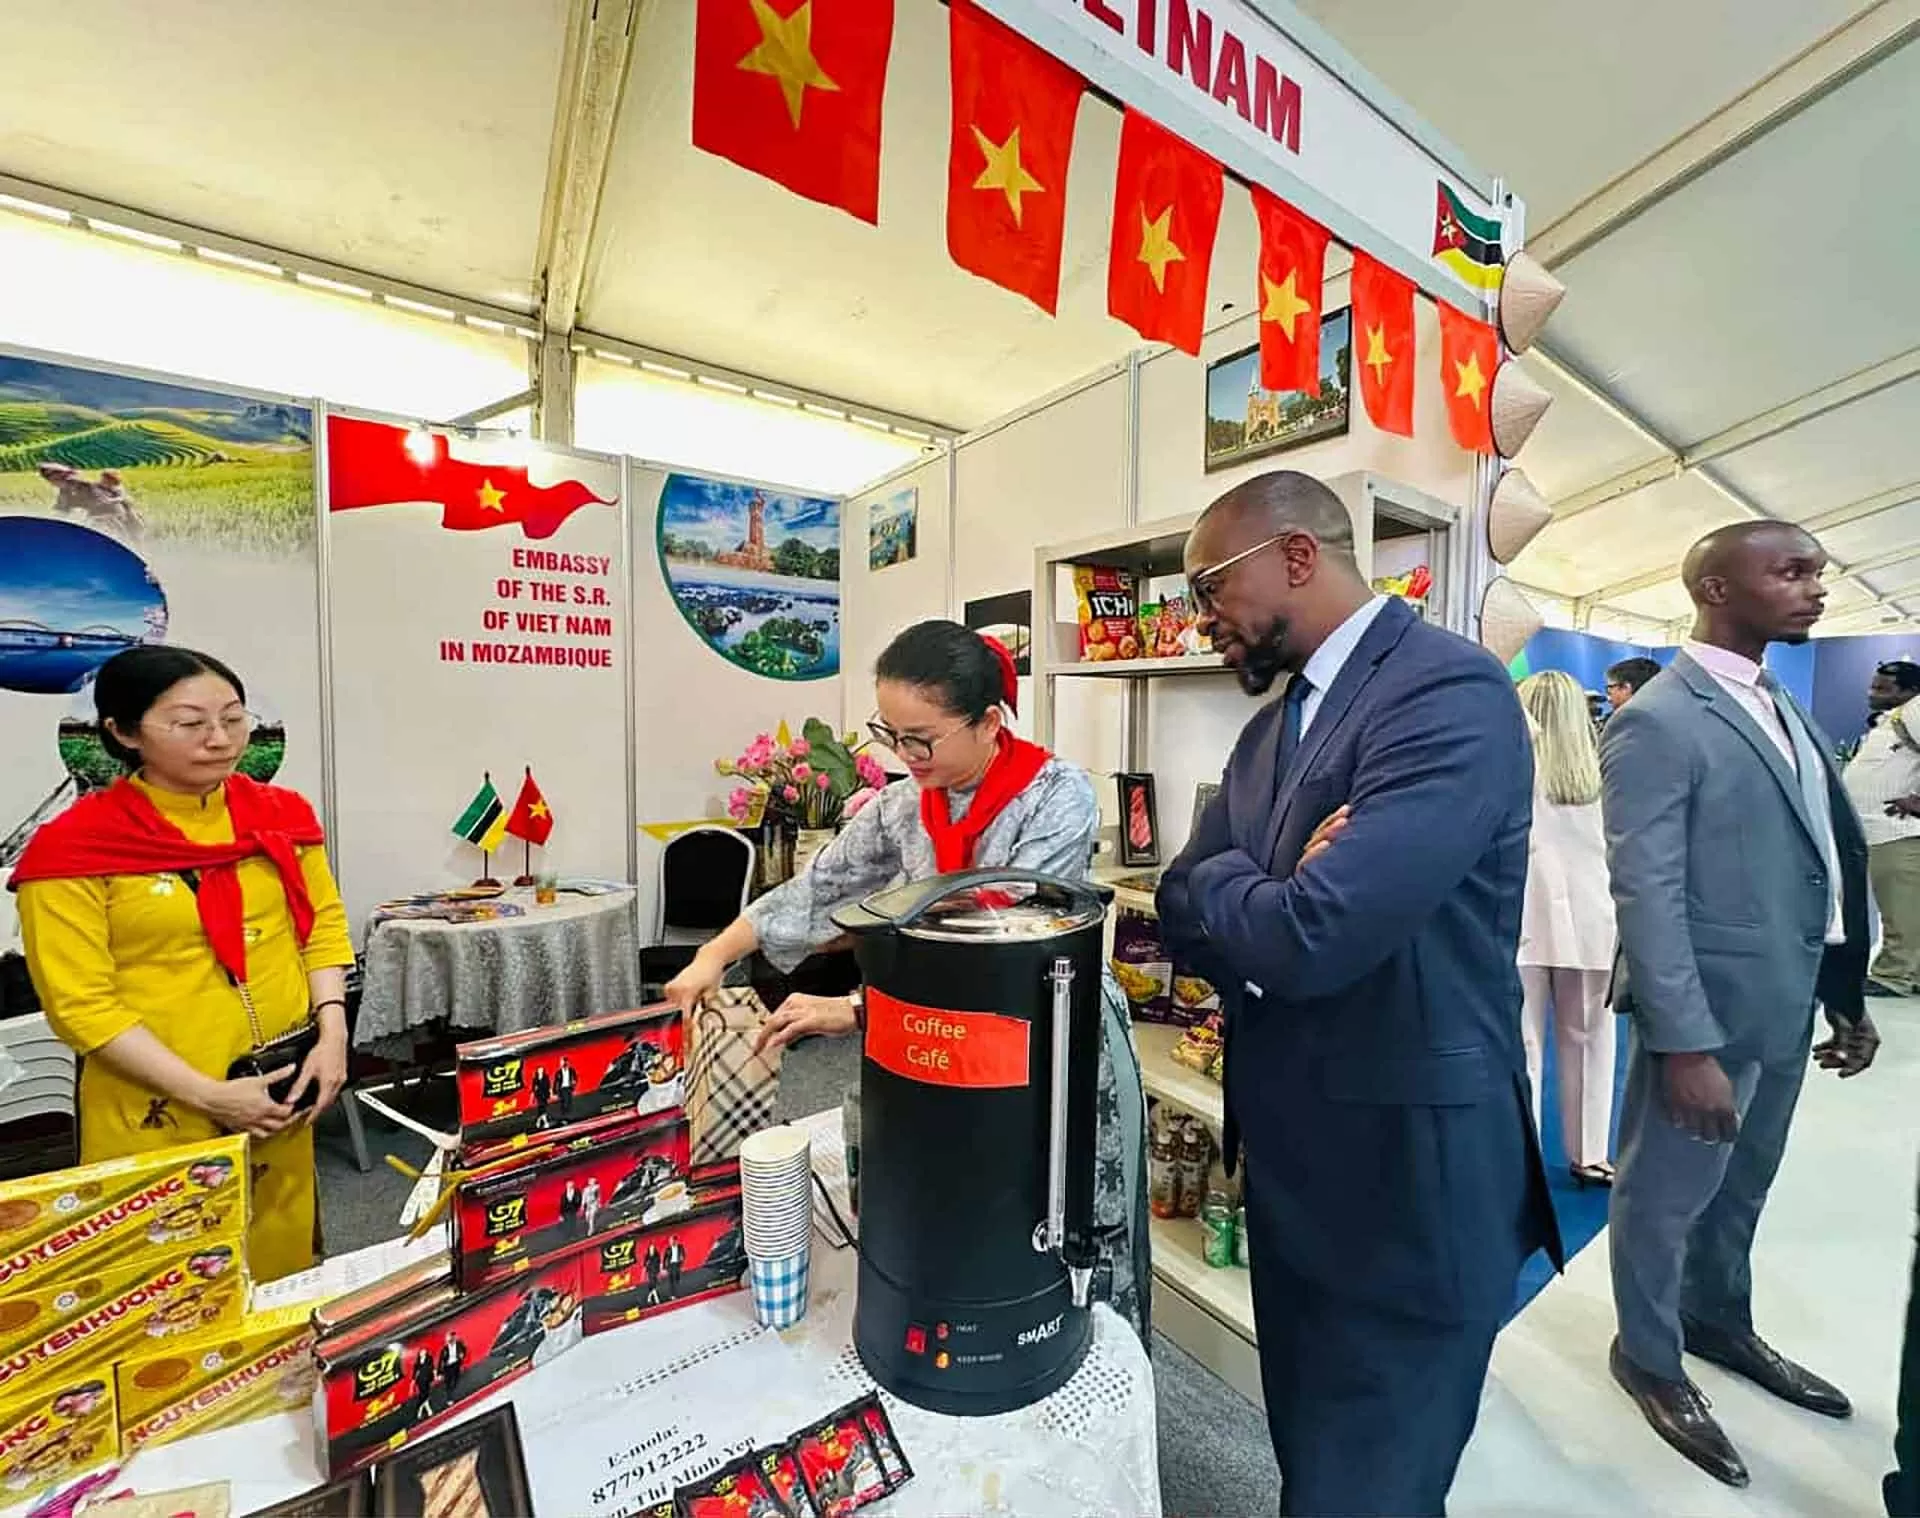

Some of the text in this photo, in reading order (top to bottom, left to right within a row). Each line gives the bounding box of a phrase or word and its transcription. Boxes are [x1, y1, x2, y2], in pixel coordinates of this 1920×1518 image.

[513, 548, 610, 576] EMBASSY
[497, 579, 611, 606] OF THE S.R.
[483, 610, 612, 636] OF VIET NAM
[440, 641, 612, 668] IN MOZAMBIQUE
[903, 1013, 967, 1040] Coffee
[906, 1044, 950, 1070] Café
[1018, 1312, 1065, 1345] SMART
[591, 1433, 708, 1505] 877912222
[672, 1455, 721, 1486] Minh
